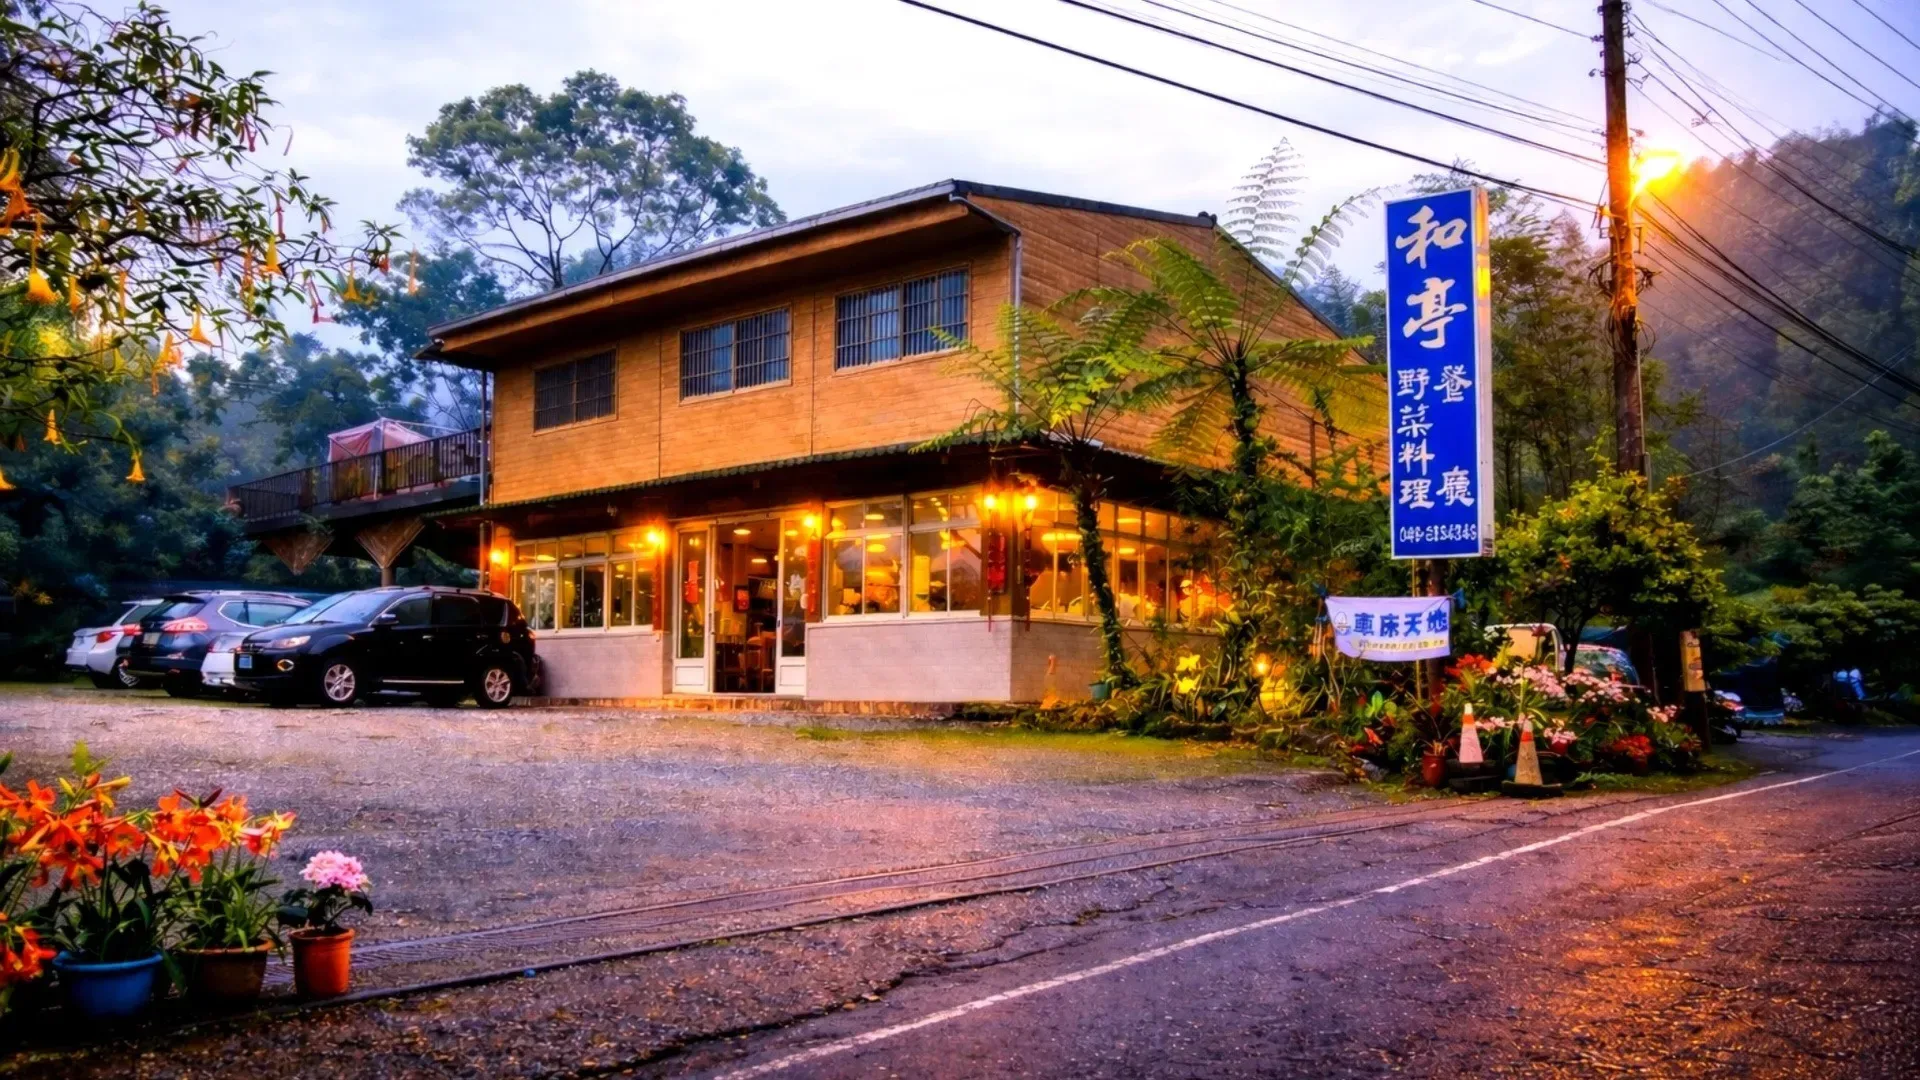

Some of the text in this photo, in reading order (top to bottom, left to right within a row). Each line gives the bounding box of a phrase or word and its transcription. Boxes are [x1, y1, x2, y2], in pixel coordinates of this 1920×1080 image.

[1396, 205, 1468, 349] 和亭
[1396, 368, 1436, 510] 野菜料理
[1353, 608, 1448, 638] 車床天地
